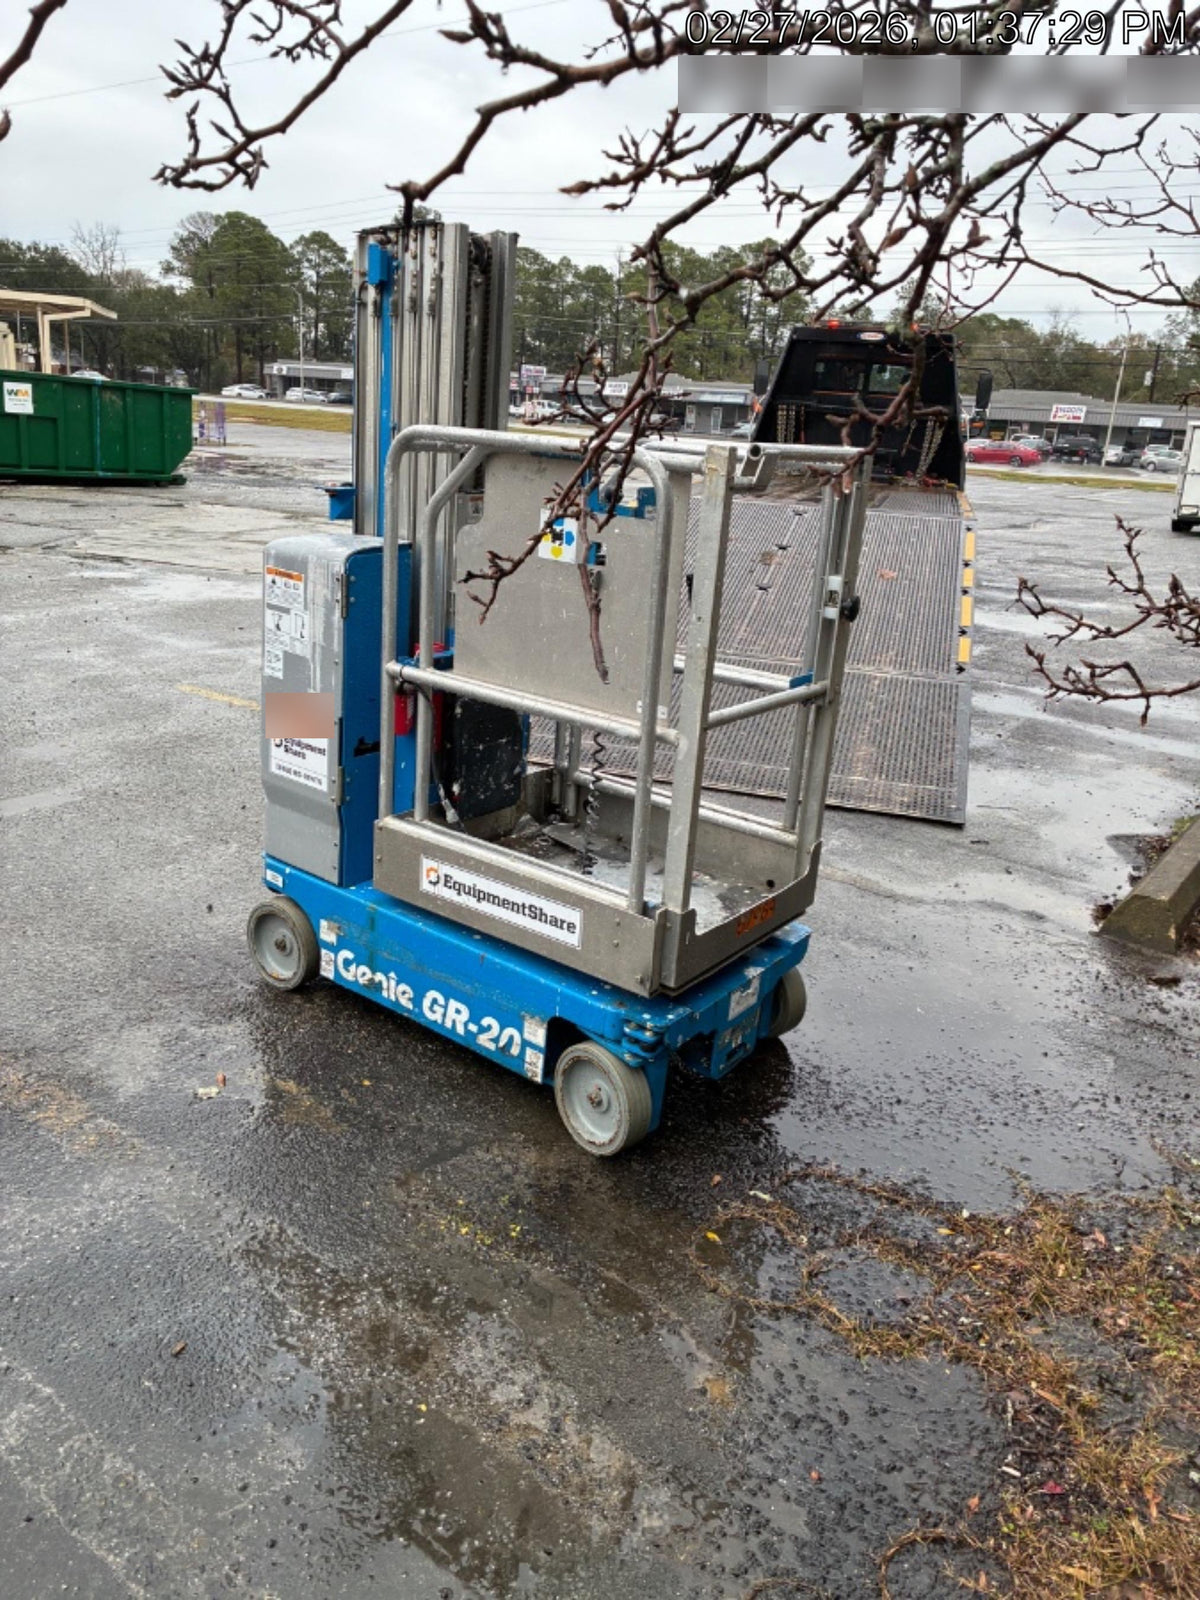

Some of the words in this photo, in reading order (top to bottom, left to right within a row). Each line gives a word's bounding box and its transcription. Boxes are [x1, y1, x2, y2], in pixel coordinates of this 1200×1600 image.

[443, 873, 577, 934] EquipmentShare
[336, 948, 414, 1010] Genie
[421, 989, 522, 1057] GR-20
